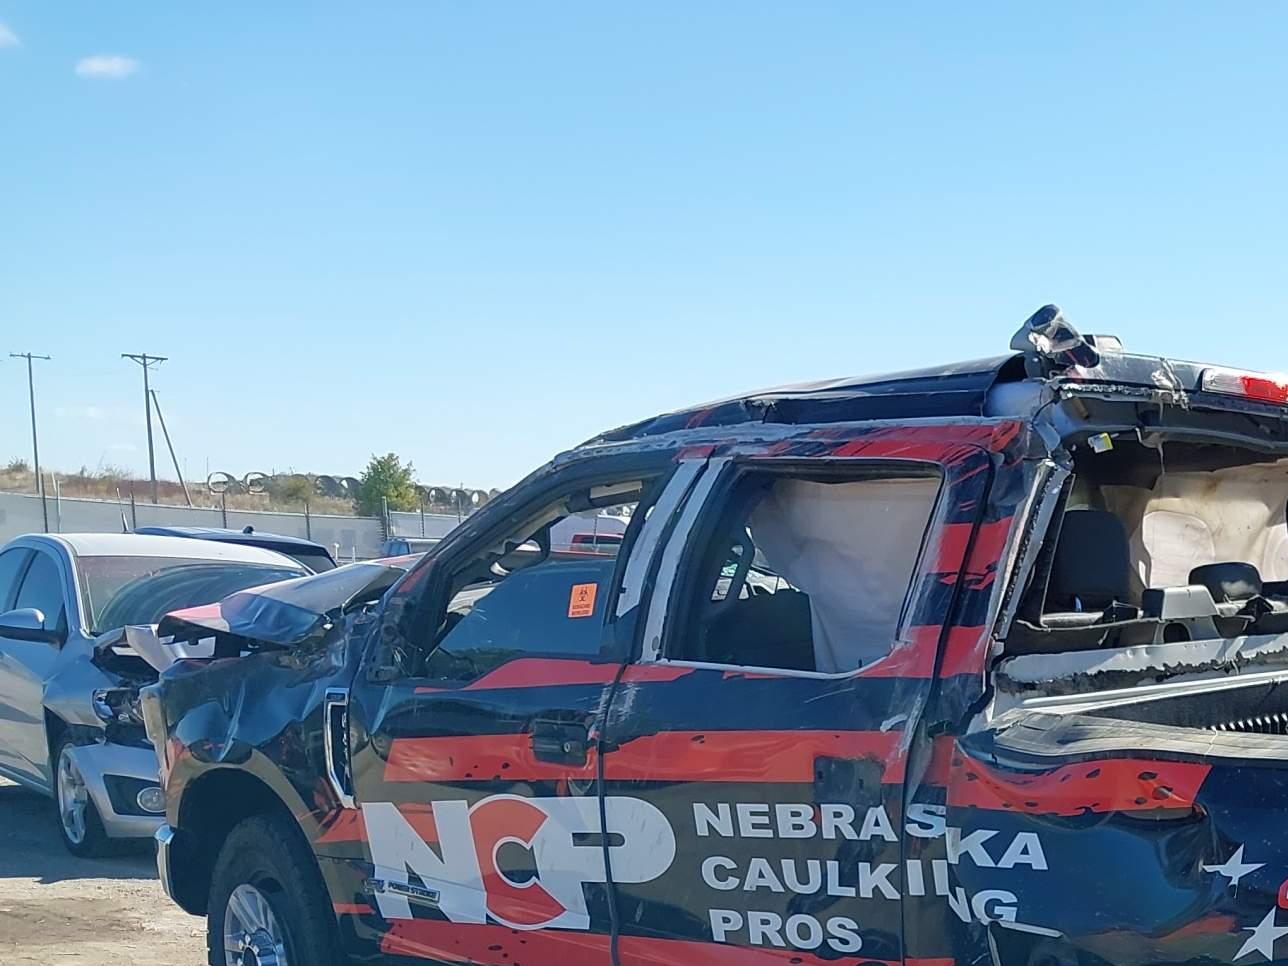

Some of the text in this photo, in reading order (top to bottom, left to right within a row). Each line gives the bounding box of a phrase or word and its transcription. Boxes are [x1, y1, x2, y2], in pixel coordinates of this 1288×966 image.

[360, 793, 677, 930] NCP
[692, 802, 1050, 871] NEBRASKA
[701, 855, 1019, 925] CAULKING
[710, 908, 863, 953] PROS
